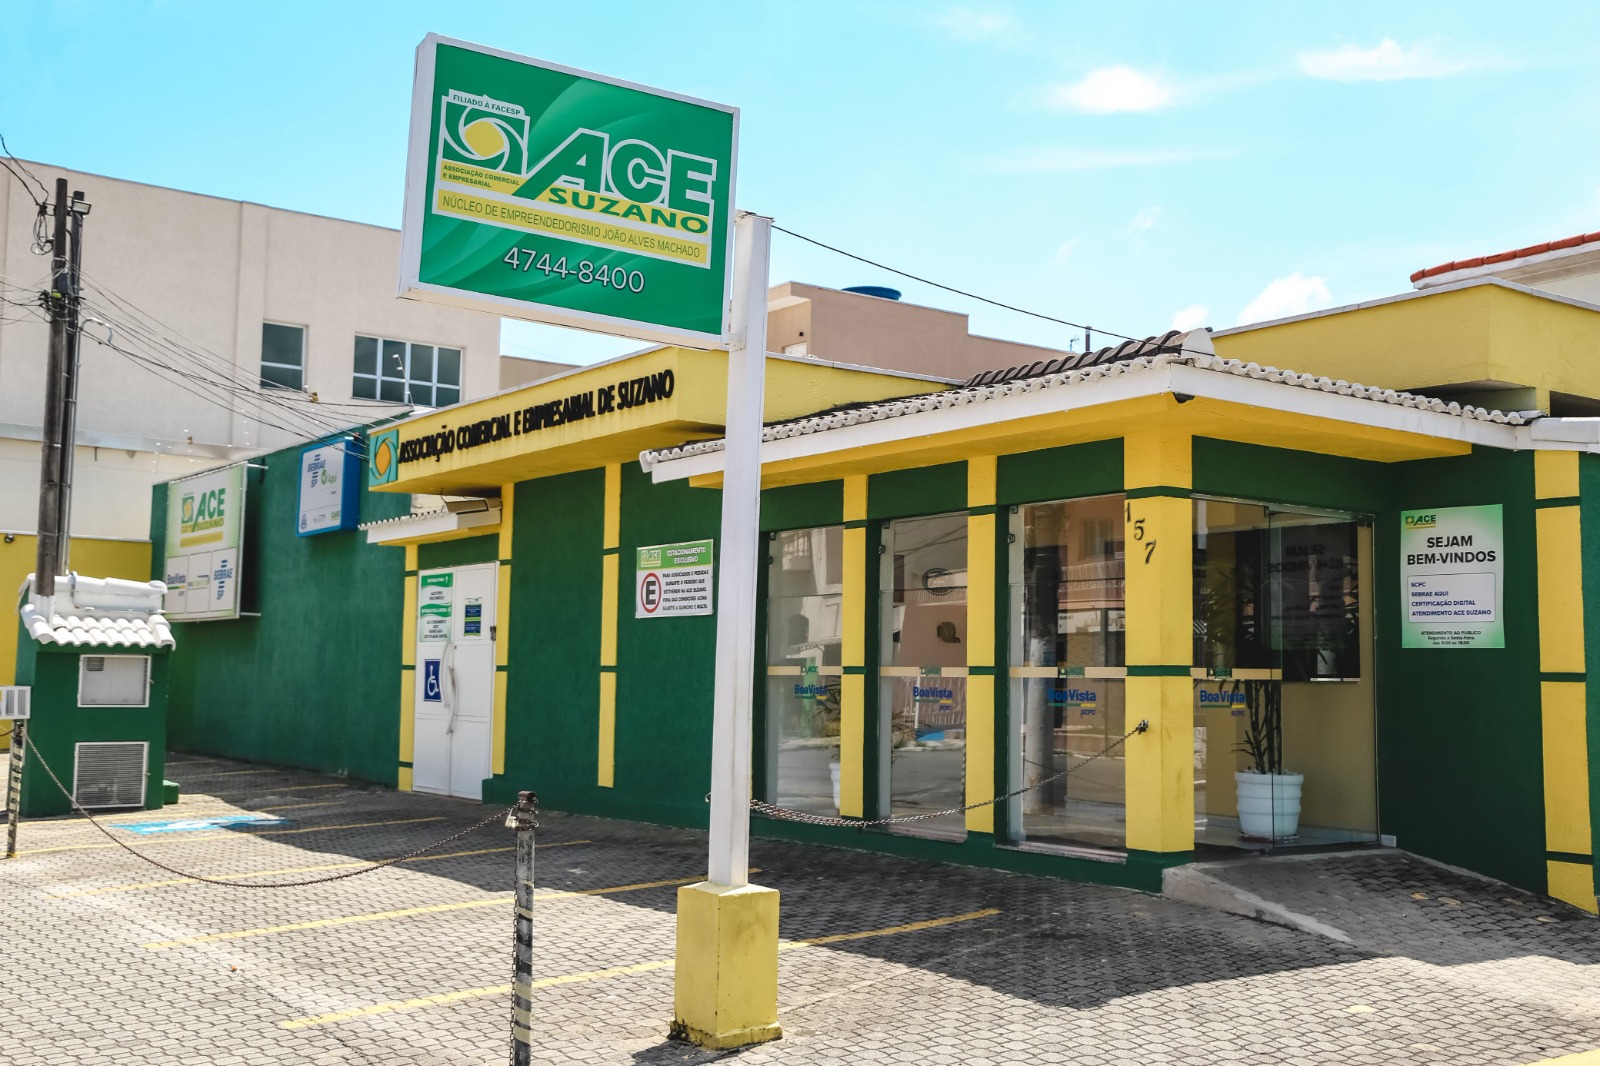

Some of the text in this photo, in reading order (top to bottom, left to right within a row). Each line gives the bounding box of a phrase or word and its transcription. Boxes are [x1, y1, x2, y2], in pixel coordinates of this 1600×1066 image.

[453, 94, 521, 116] FILIADO À FACESP
[443, 164, 520, 186] ASSOCIAÇÃO COMERCIAL
[513, 127, 717, 217] ACE
[449, 173, 492, 188] EMPRESARIAL
[548, 187, 708, 234] SUZANO
[443, 195, 700, 258] NÚCLEO DE EMPREENDEDORISMO JOÃO ALVES MACHADO
[503, 247, 645, 293] 4744-8400
[398, 369, 674, 464] ASSOCIAÇÃO COMERCIAL E EMPRESARIAL DE SUZANO
[308, 460, 326, 472] SEBRAE
[192, 488, 226, 532] ACE
[197, 517, 224, 531] SUZANO
[1413, 515, 1437, 526] ACE
[1427, 535, 1472, 548] SEJAM
[647, 551, 661, 562] ACE
[667, 547, 706, 556] ESTACIONAMENTO
[1407, 550, 1496, 565] BEM-VINDOS
[674, 556, 698, 564] EXCLUSIVO
[167, 573, 186, 584] BoaVista
[214, 568, 233, 580] SEBRAE
[646, 581, 656, 605] E
[1411, 599, 1452, 607] CERTIFICAÇÃO
[795, 684, 827, 695] BoaVista
[913, 686, 952, 699] BoaVista
[1048, 688, 1096, 702] BoaVista
[1200, 690, 1246, 703] BoaVista
